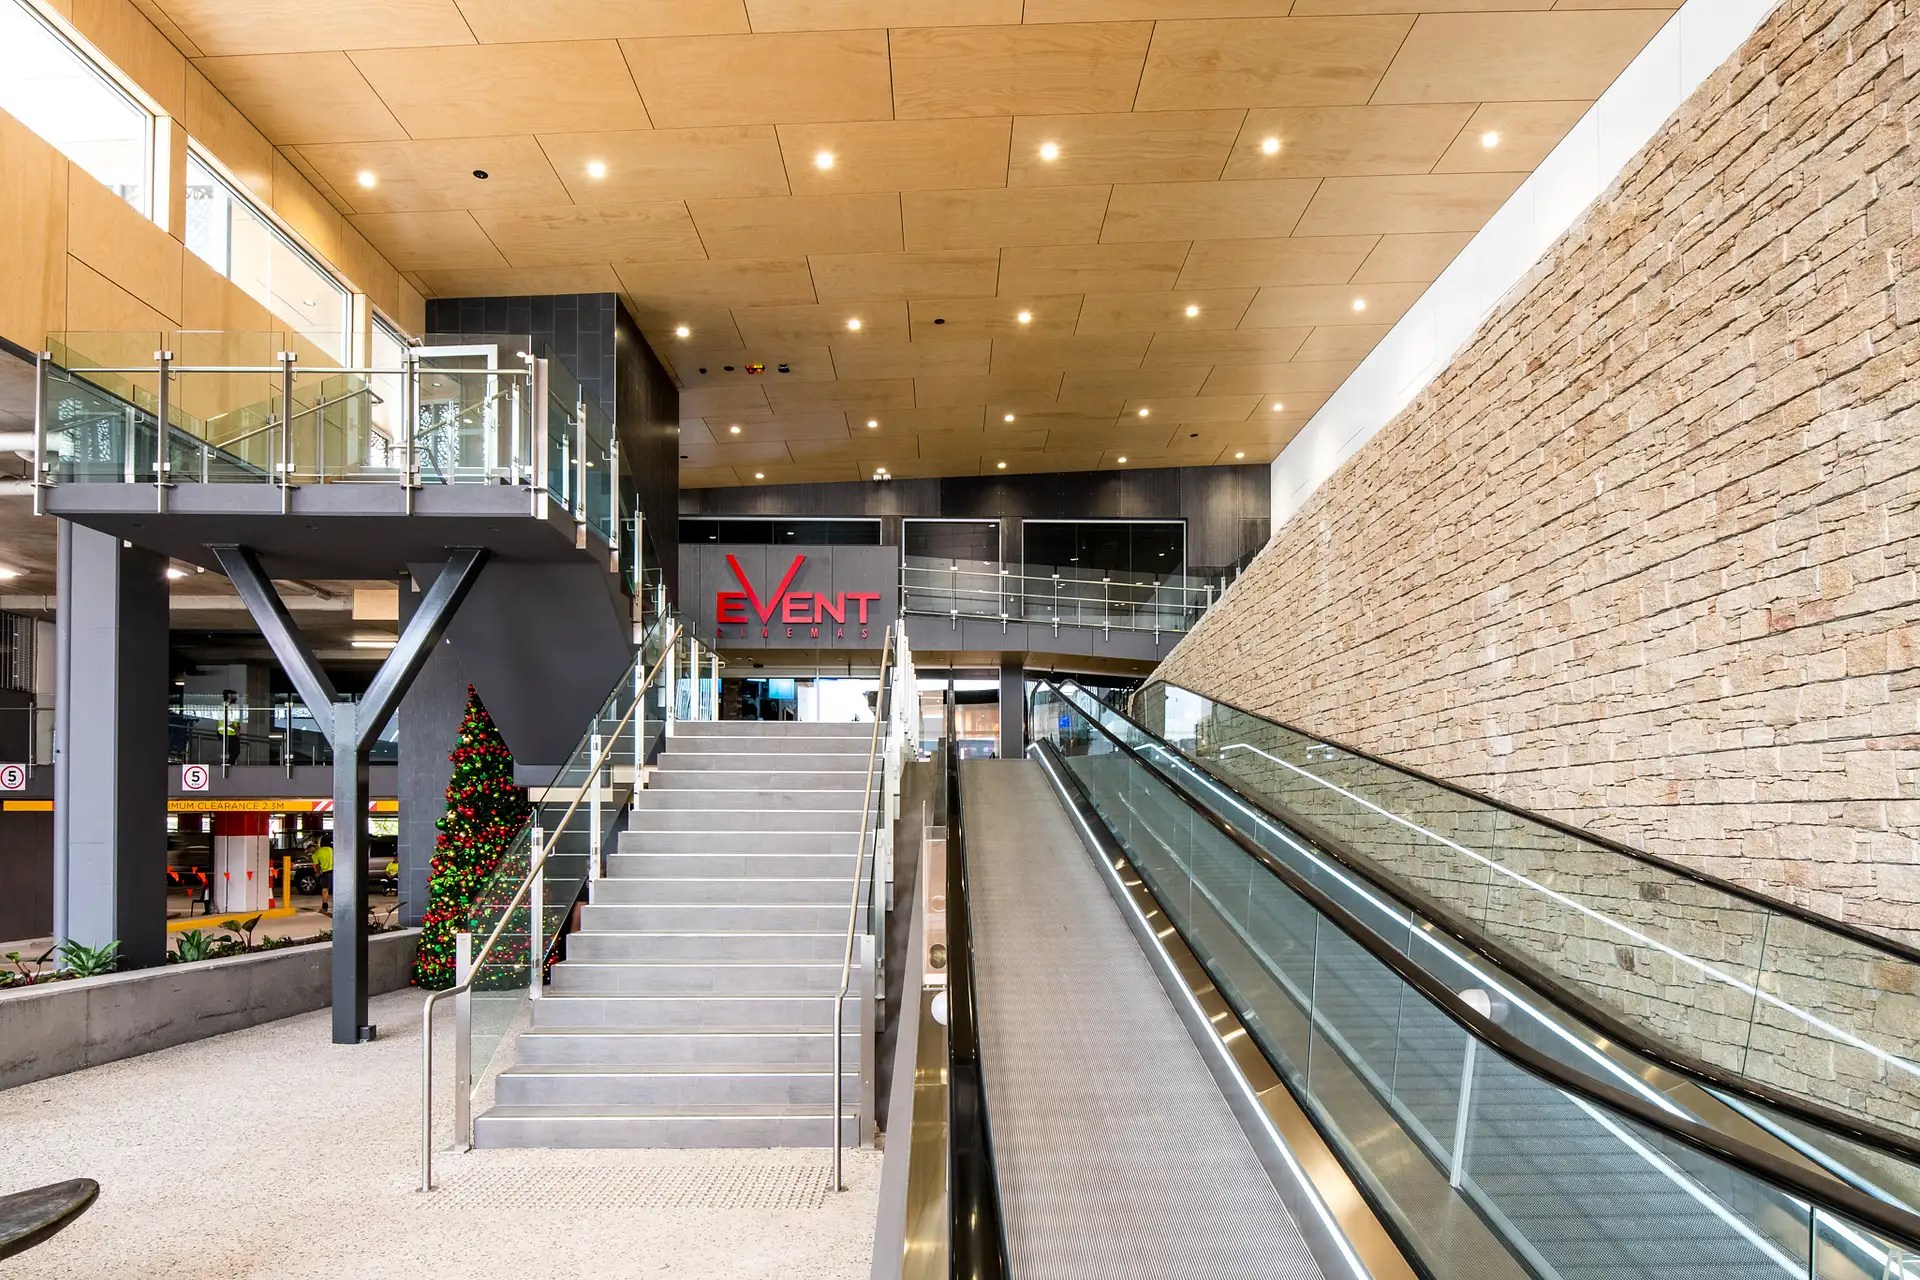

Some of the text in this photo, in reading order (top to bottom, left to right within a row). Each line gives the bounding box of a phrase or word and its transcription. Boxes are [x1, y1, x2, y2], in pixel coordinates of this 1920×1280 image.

[716, 554, 880, 625] EVENT
[716, 627, 868, 639] CINEMAS
[8, 770, 17, 782] 5
[191, 771, 200, 782] 5
[168, 802, 284, 810] IMUM CLEARANCE 2.3M
